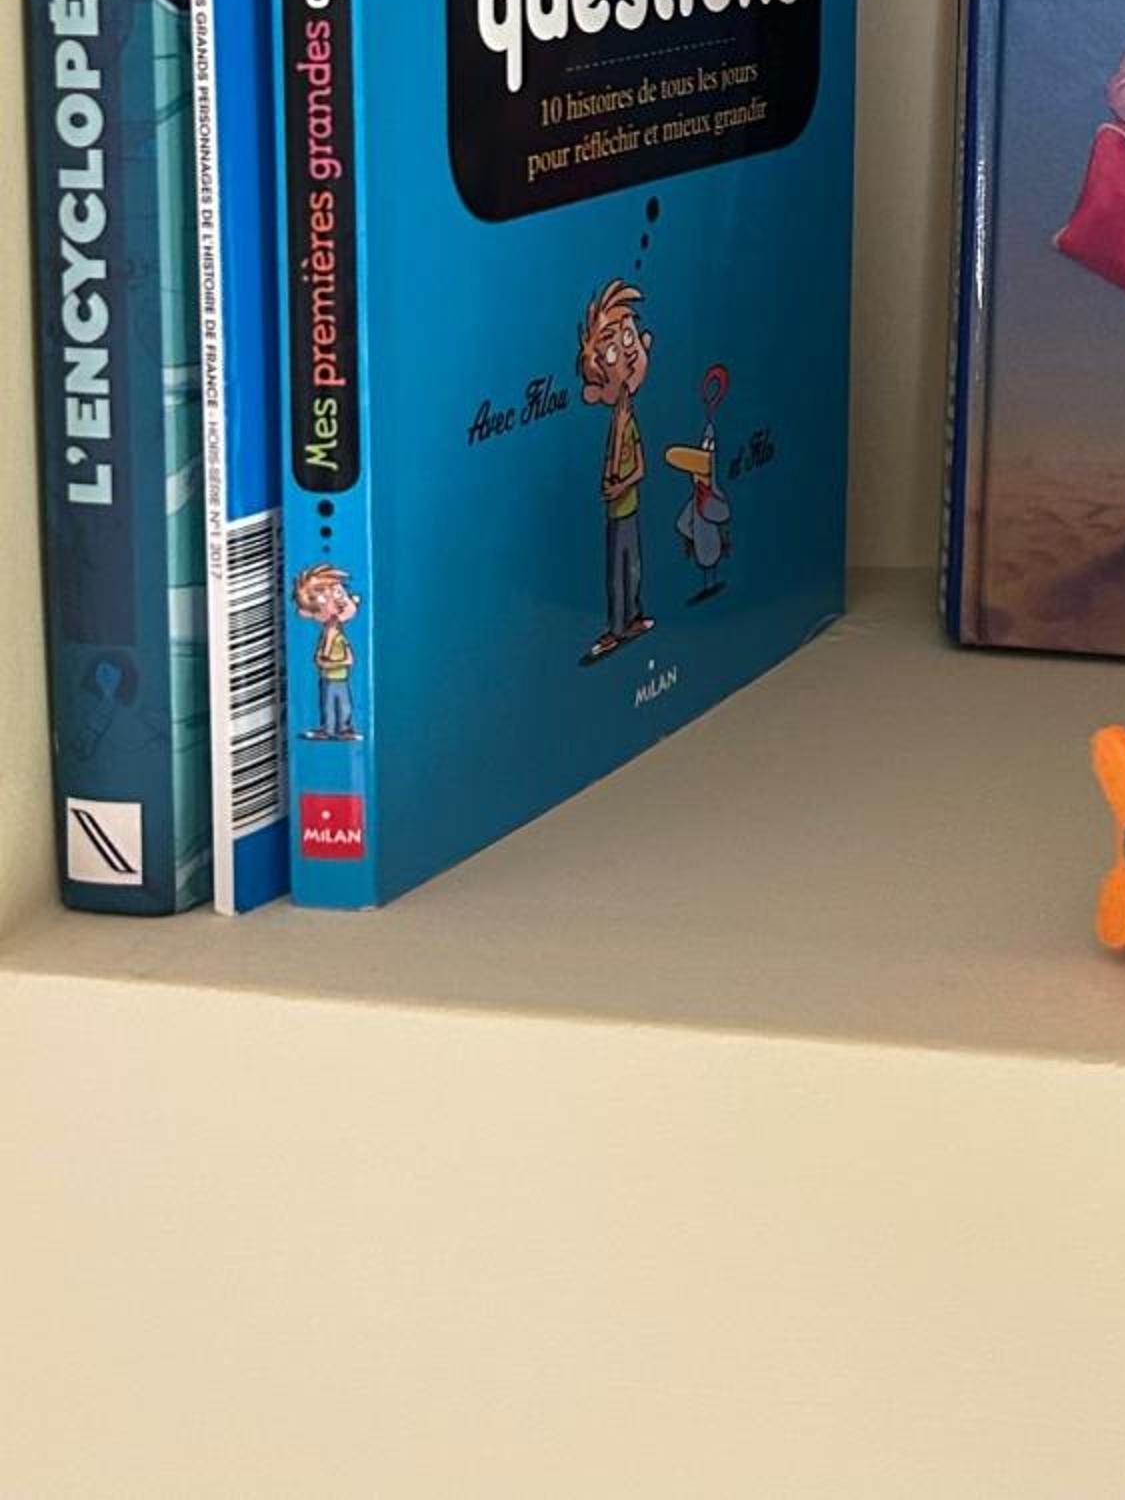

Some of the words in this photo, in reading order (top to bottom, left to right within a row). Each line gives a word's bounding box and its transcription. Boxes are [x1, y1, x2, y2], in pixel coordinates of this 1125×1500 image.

[195, 12, 209, 81] GRANDS
[296, 20, 342, 181] grandes
[541, 97, 563, 126] 10
[567, 85, 633, 121] histoires
[638, 77, 657, 103] de
[661, 74, 694, 100] tous
[698, 67, 718, 92] les
[720, 62, 758, 92] jours
[197, 86, 214, 205] PERSONNAGES
[527, 146, 570, 183] pour
[575, 123, 639, 164] réfléchir
[644, 124, 660, 146] et
[664, 112, 711, 142] mieux
[715, 96, 768, 136] grandir
[202, 209, 214, 228] DE
[301, 191, 345, 388] premières
[205, 320, 217, 340] DE
[206, 346, 219, 408] FRANCE
[305, 397, 340, 471] Mes
[468, 398, 515, 446] Avec
[210, 542, 222, 580] 2017
